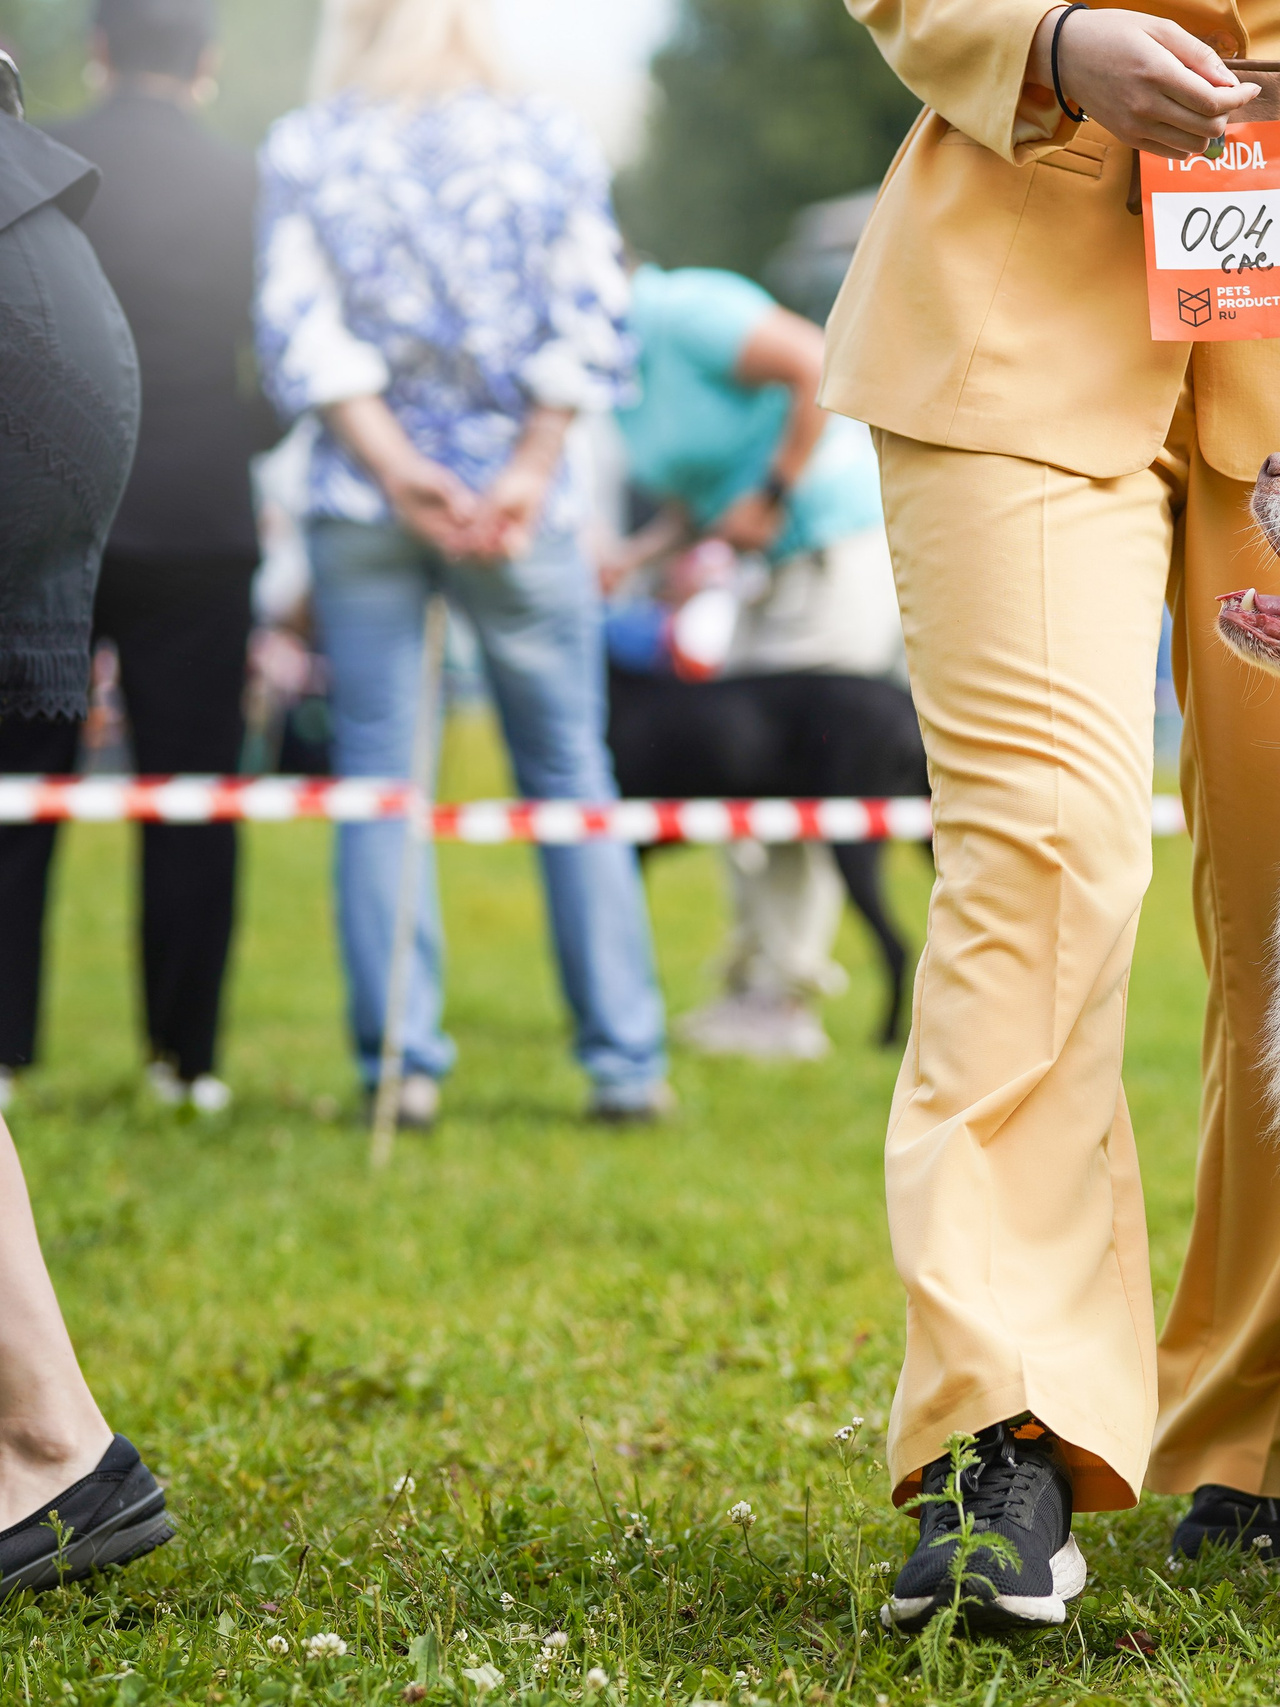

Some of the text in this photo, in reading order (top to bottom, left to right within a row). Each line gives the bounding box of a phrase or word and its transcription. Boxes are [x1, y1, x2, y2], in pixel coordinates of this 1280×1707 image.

[1181, 205, 1273, 252] 004
[1217, 286, 1251, 297] PETS
[1217, 296, 1280, 309] PRODUCT
[1219, 311, 1237, 320] RU
